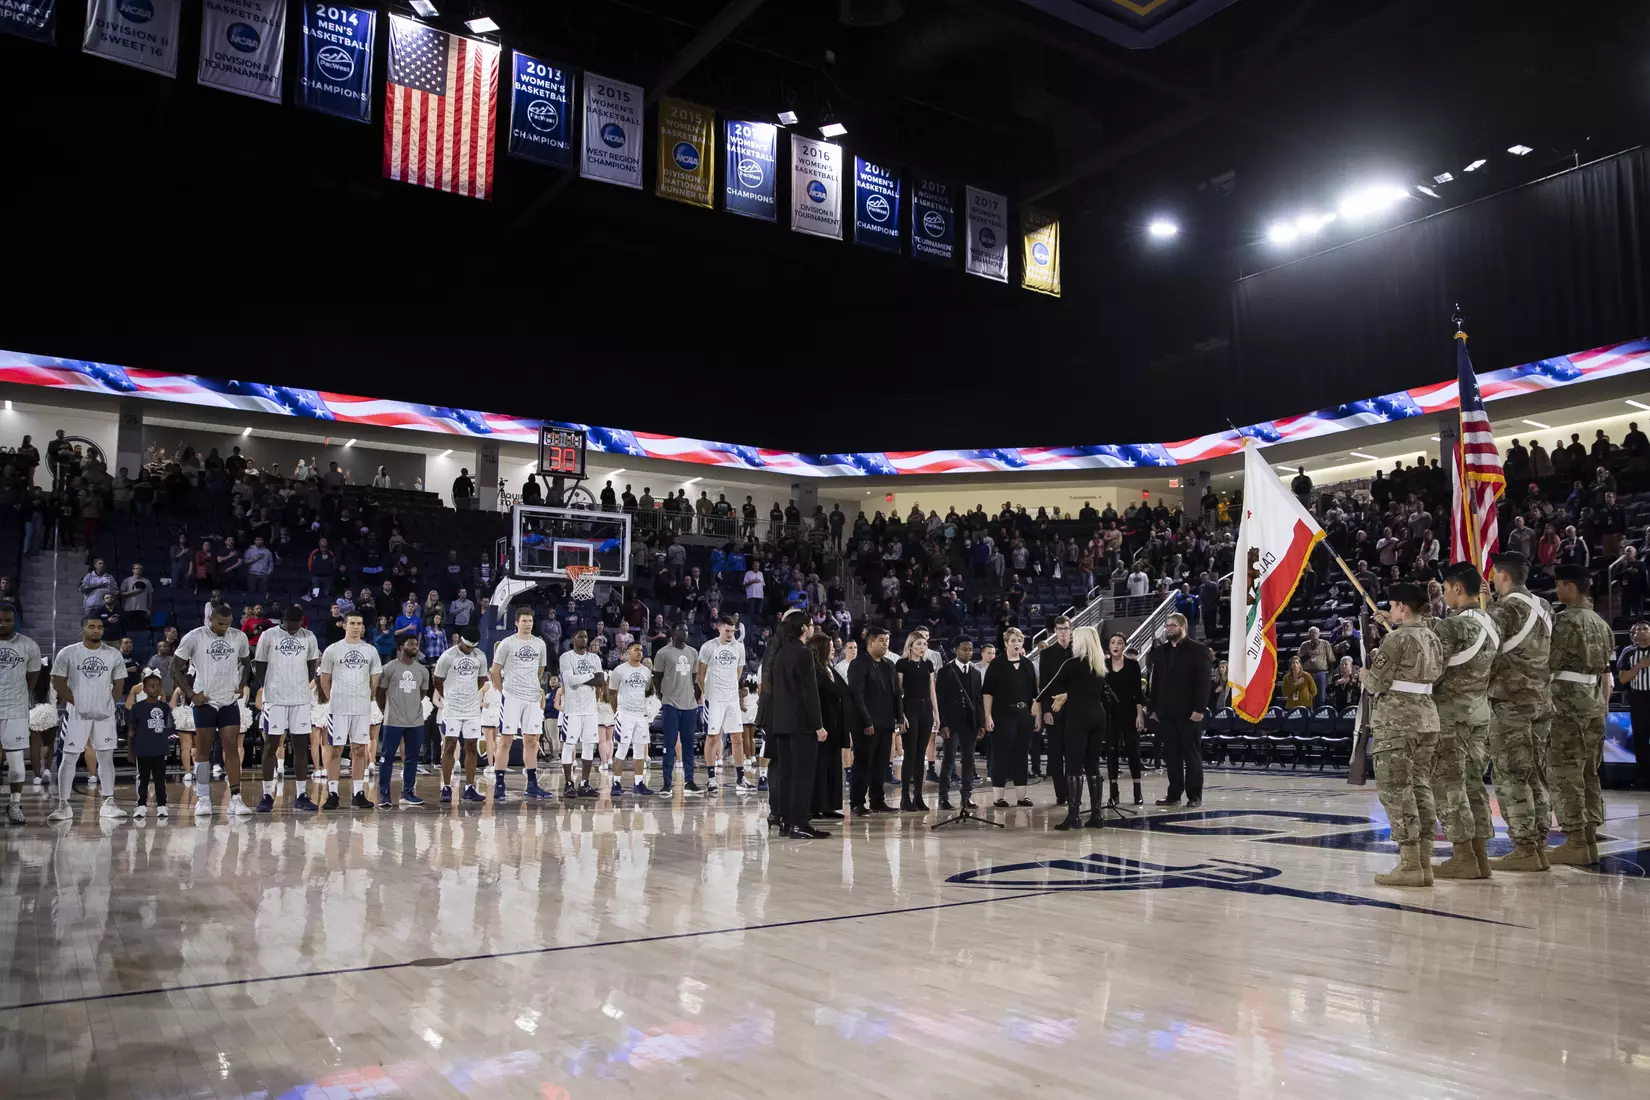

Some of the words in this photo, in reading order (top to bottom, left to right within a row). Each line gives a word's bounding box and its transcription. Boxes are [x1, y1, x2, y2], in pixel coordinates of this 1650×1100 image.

[207, 1, 281, 28] BASKETBALL
[316, 4, 358, 26] 2014
[96, 18, 156, 43] DIVISION
[161, 37, 168, 46] II
[318, 20, 353, 36] MEN'S
[100, 33, 146, 51] SWEET
[150, 47, 163, 56] 16
[231, 34, 259, 47] NCAA
[303, 25, 370, 51] BASKETBALL
[214, 52, 261, 70] DIVISION
[320, 60, 350, 73] PacWest
[204, 59, 279, 84] TOURNAMENT
[527, 62, 562, 81] 2013
[301, 78, 367, 101] CHAMPIONS
[520, 74, 565, 92] WOMEN'S
[515, 82, 569, 103] BASKETBALL
[597, 85, 630, 102] 2015
[592, 98, 634, 114] WOMEN'S
[587, 106, 640, 125] BASKETBALL
[671, 107, 702, 124] 2015
[665, 118, 705, 135] WOMEN'S
[513, 129, 569, 149] CHAMPIONS
[604, 133, 624, 144] NCAA
[662, 126, 711, 145] BASKETBALL
[730, 136, 768, 152] WOMEN'S
[586, 148, 608, 159] WEST
[609, 151, 639, 165] REGION
[676, 154, 699, 165] NCAA
[727, 143, 774, 162] BASKETBALL
[803, 146, 830, 161] 2016
[588, 157, 636, 172] CHAMPIONS
[798, 157, 833, 172] WOMEN'S
[865, 162, 890, 178] 2017
[664, 170, 700, 183] DIVISION
[795, 165, 838, 181] BASKETBALL
[860, 172, 894, 187] WOMEN'S
[660, 184, 696, 198] RUNNER
[664, 177, 706, 192] NATIONAL
[857, 180, 899, 198] BASKETBALL
[922, 180, 946, 194] 2017
[727, 187, 773, 203] CHAMPIONS
[809, 190, 826, 199] NCAA
[800, 204, 829, 216] DIVISION
[975, 196, 998, 210] 2017
[795, 209, 839, 226] TOURNAMENT
[857, 221, 898, 236] CHAMPIONS
[914, 236, 953, 251] TOURNAMENT
[917, 244, 952, 259] CHAMPIONS
[550, 446, 575, 471] 30
